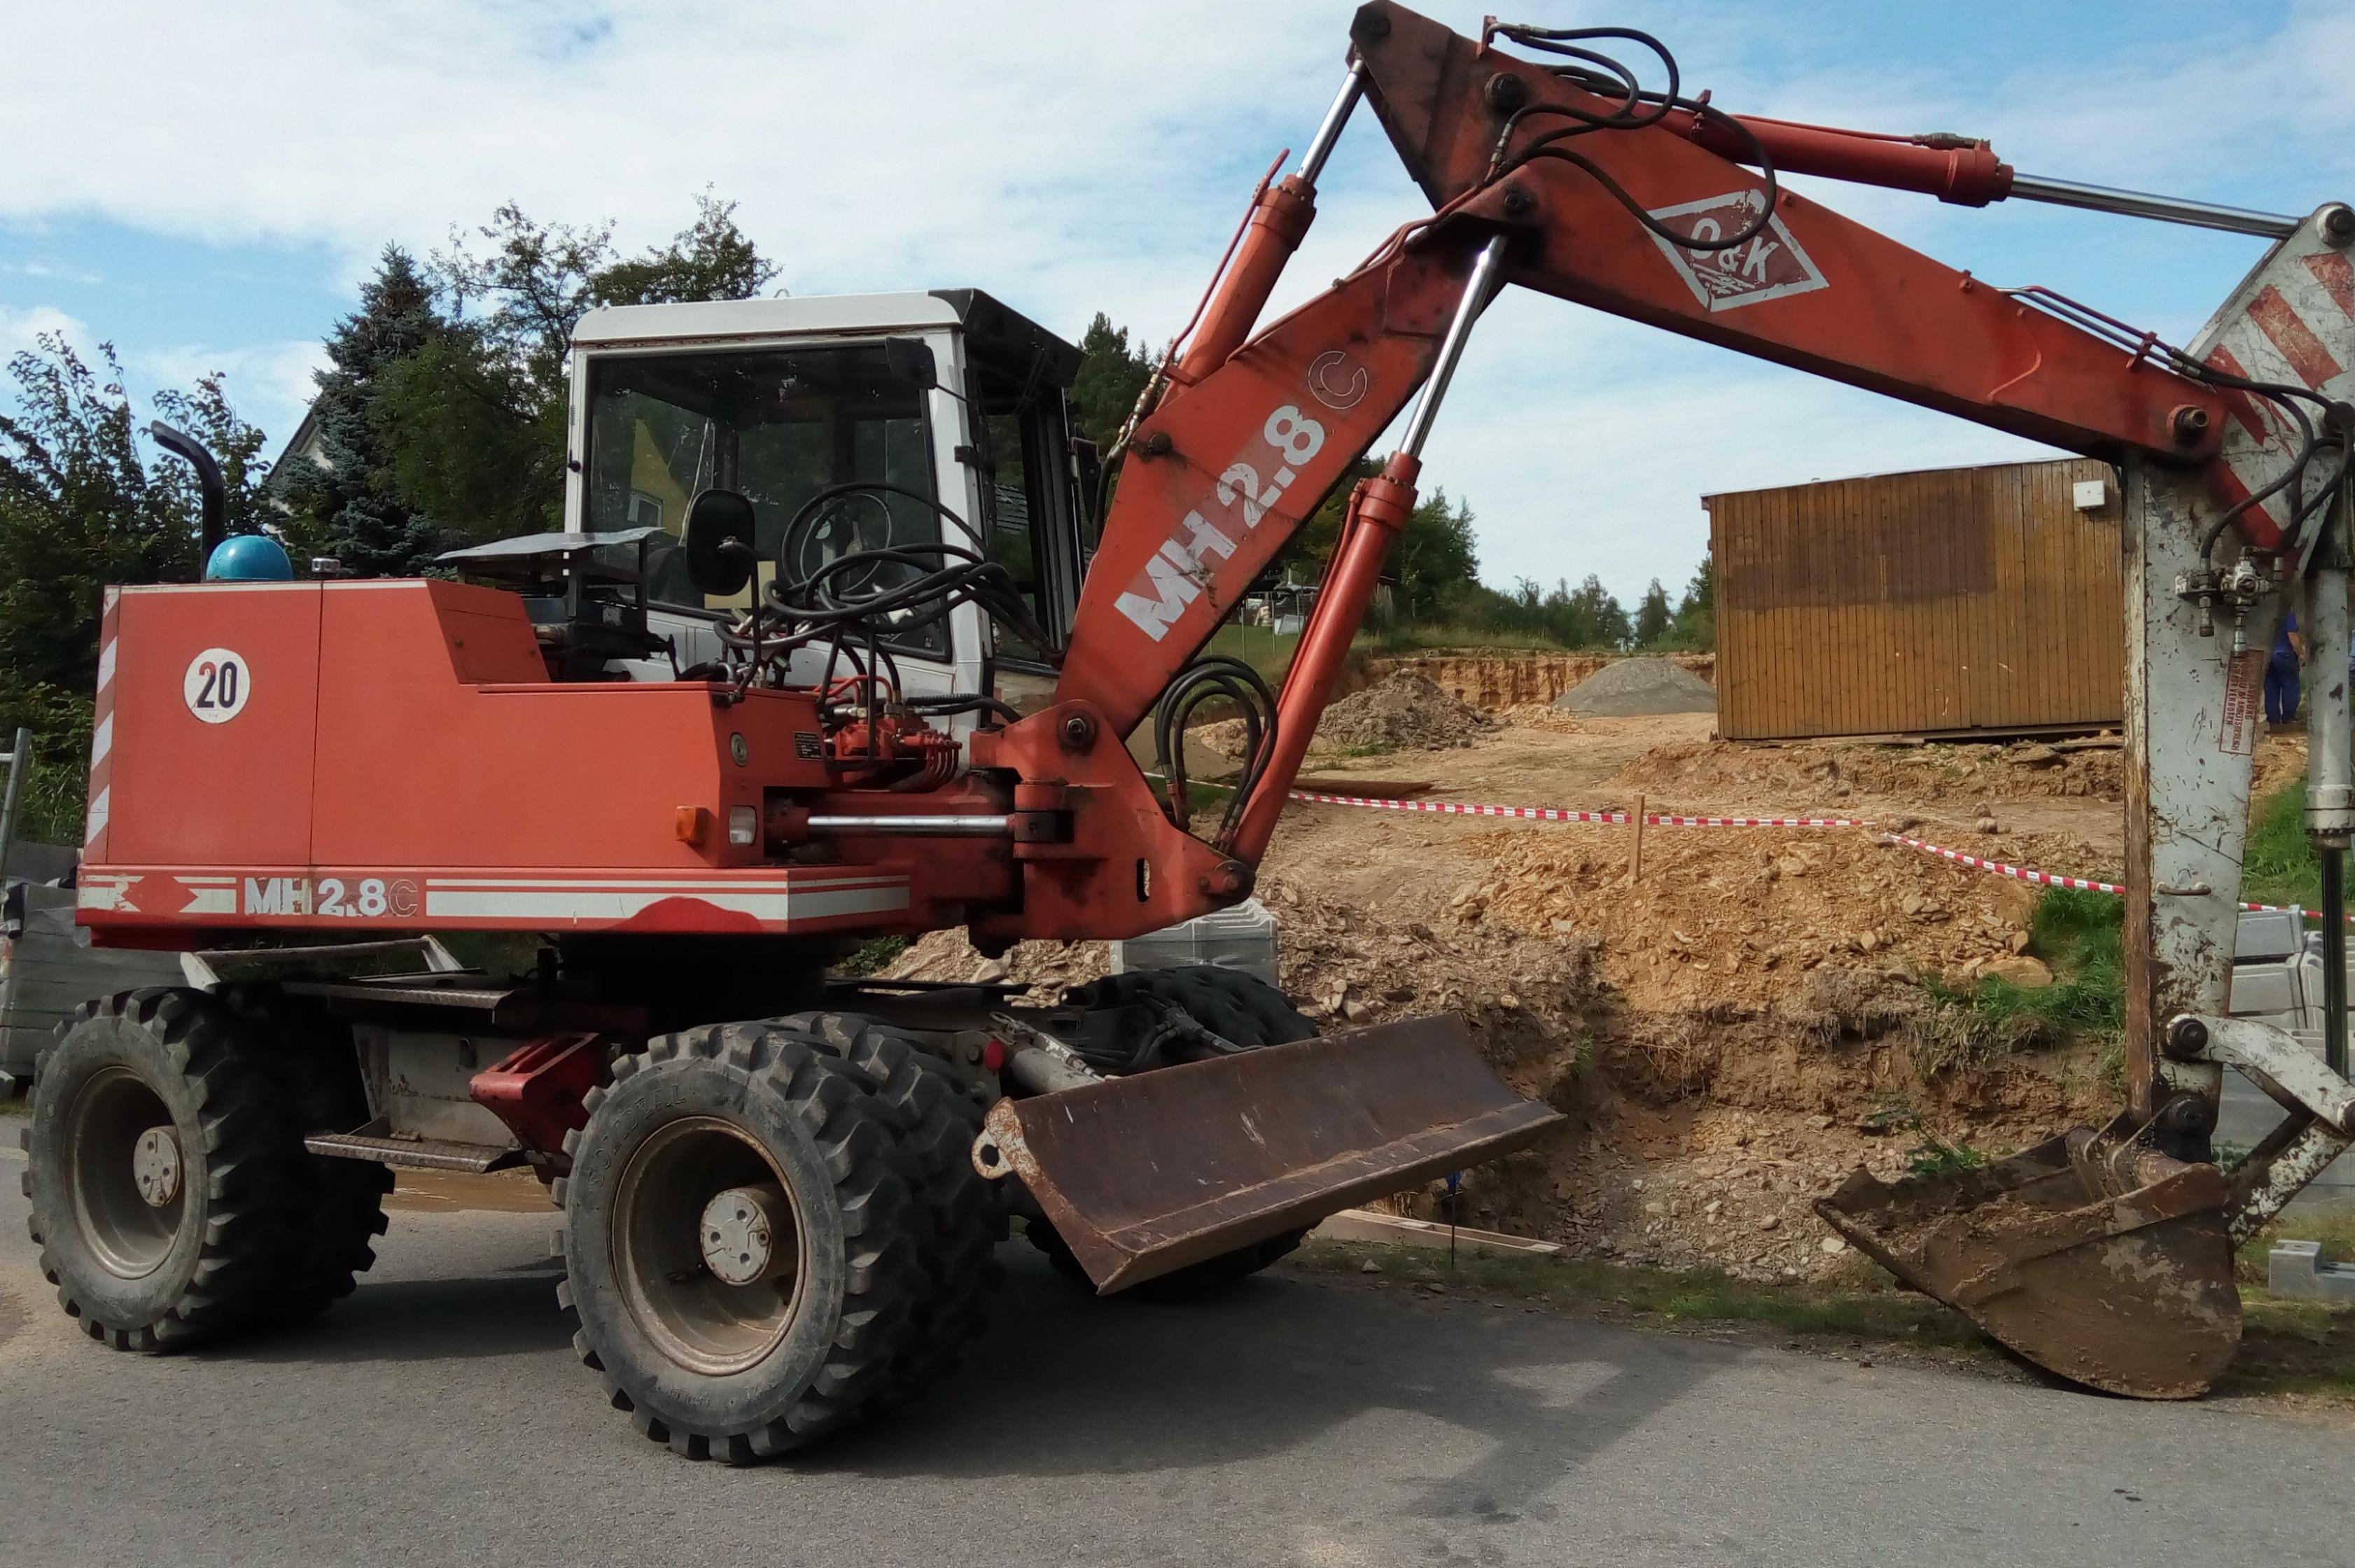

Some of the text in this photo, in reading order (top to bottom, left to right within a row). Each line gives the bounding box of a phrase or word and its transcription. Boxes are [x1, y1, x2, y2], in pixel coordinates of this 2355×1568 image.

[1114, 509, 1238, 643] MH
[197, 661, 237, 708] 20
[244, 877, 313, 915] MH
